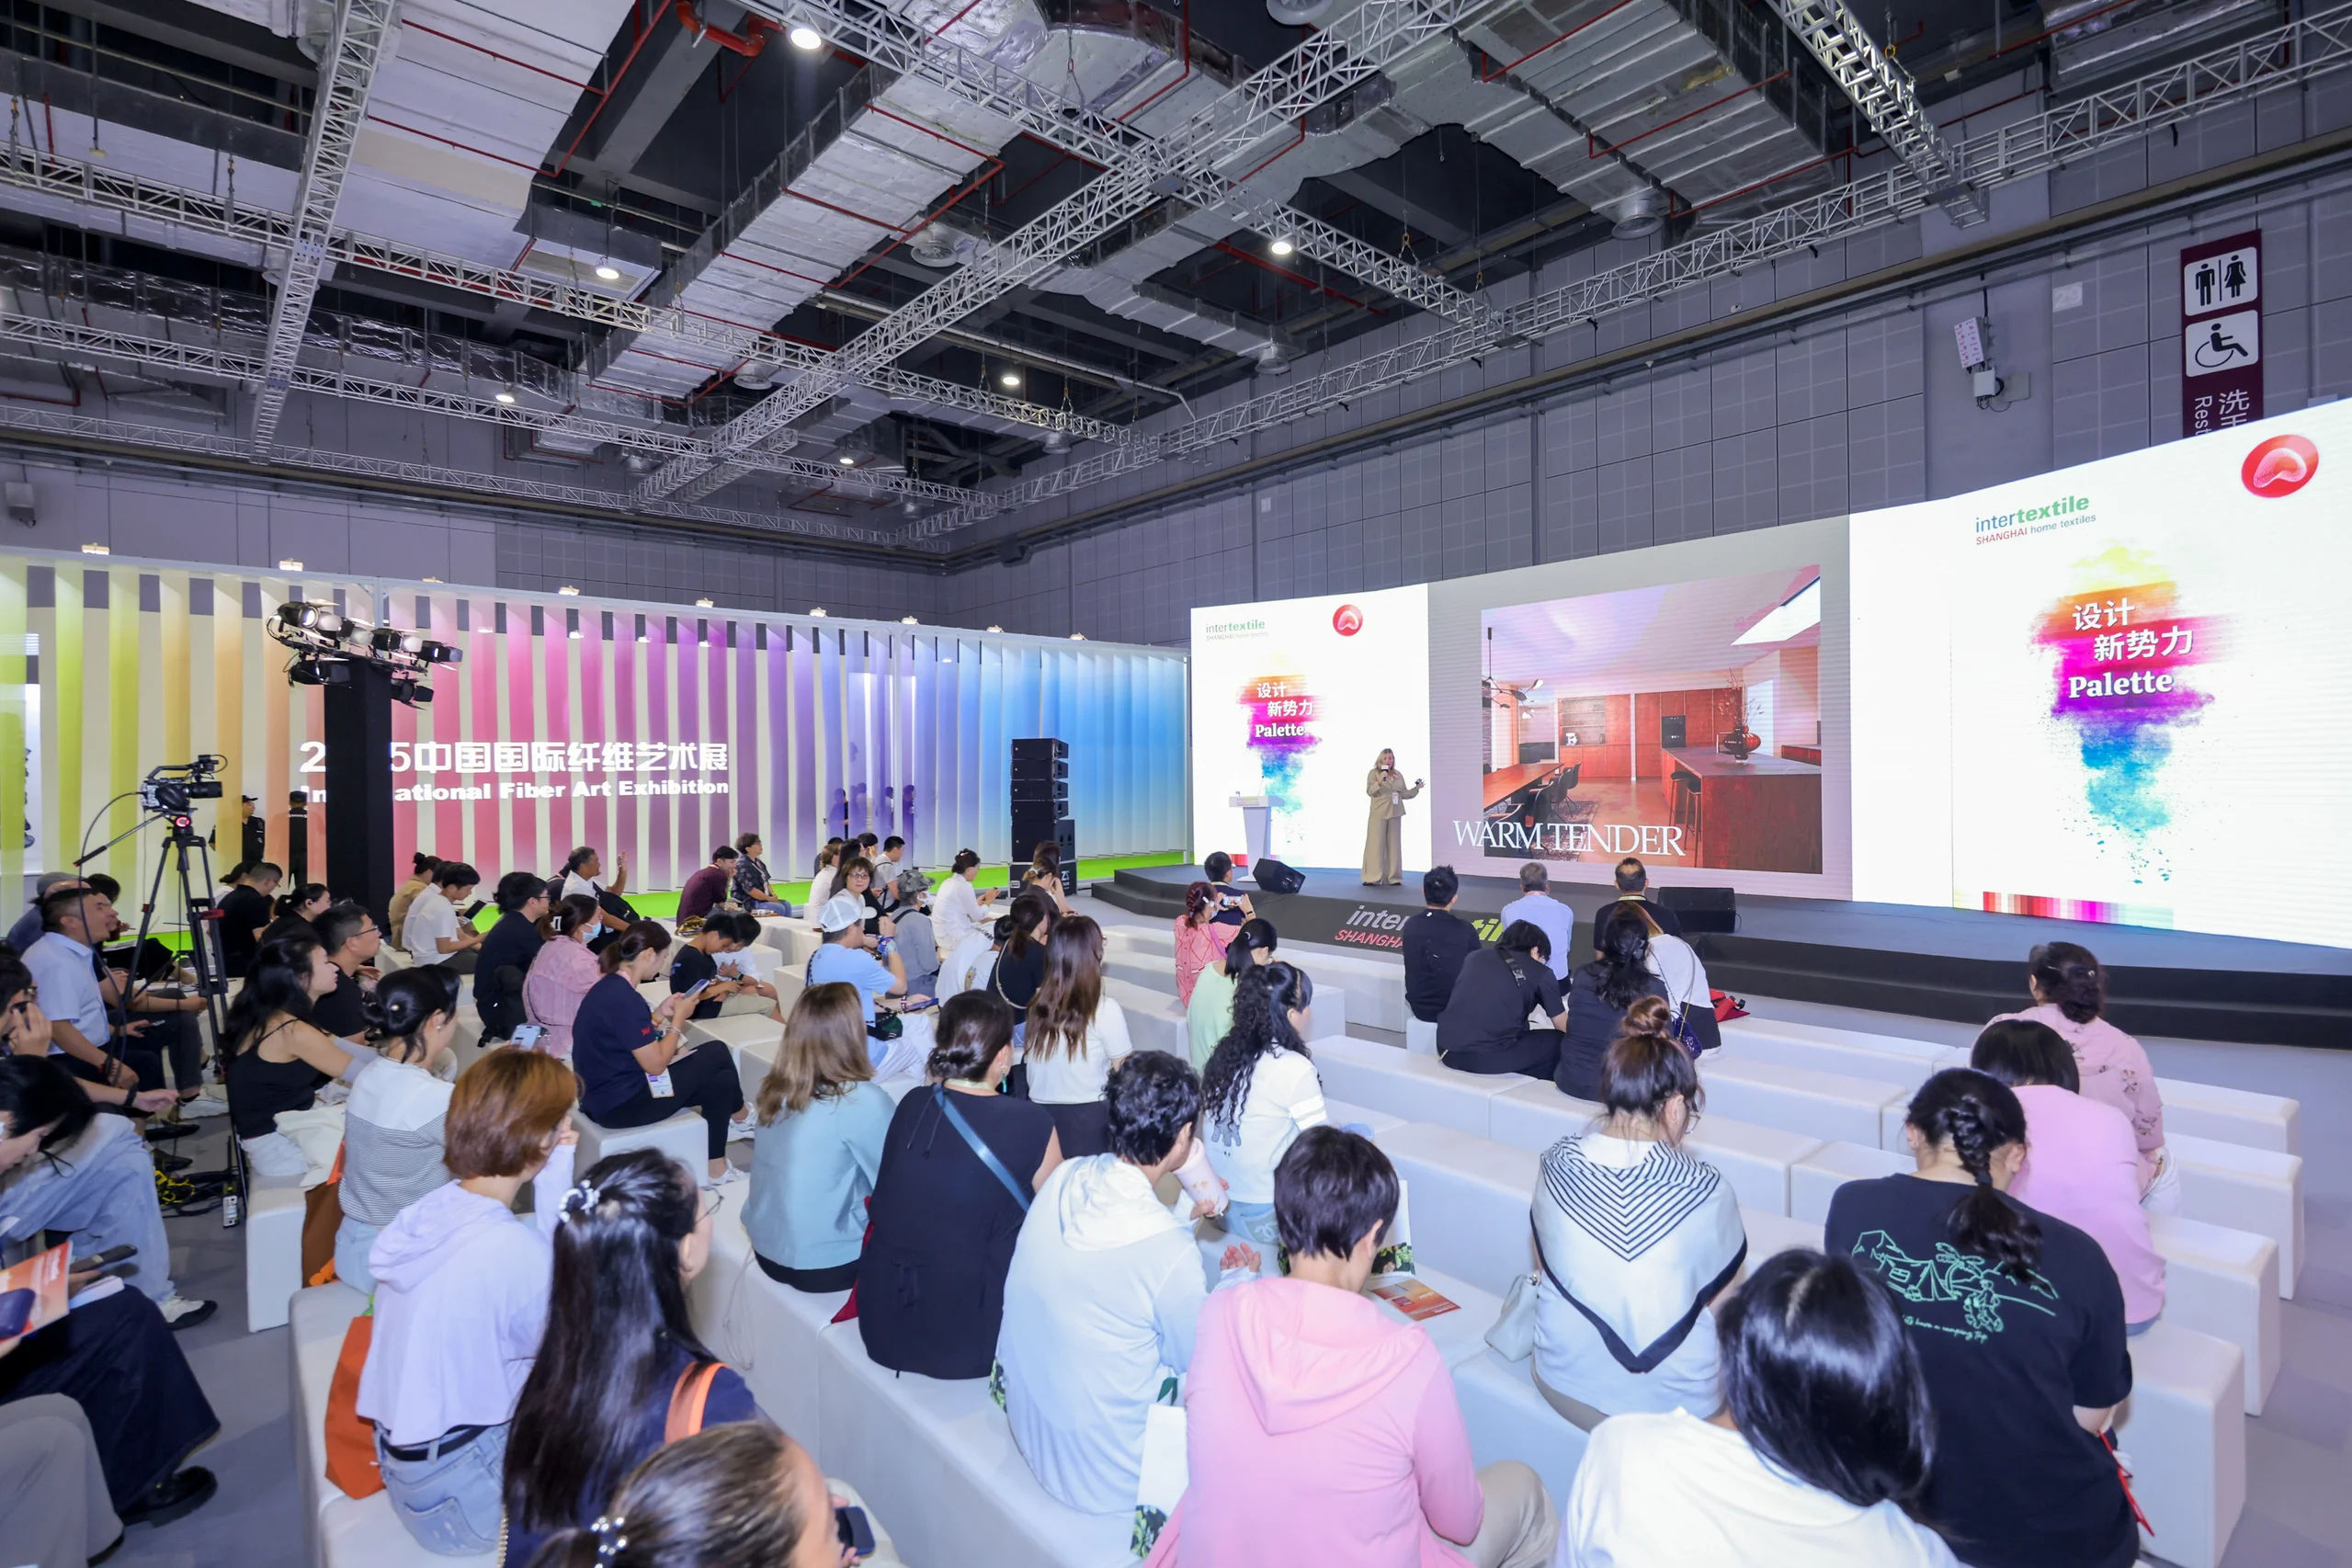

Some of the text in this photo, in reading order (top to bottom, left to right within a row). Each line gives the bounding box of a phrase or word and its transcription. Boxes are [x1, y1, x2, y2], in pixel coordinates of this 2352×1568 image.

[1976, 495, 2089, 533] intertextile
[1976, 515, 2096, 545] SHANGHAI home textiles
[1206, 619, 1266, 633] intertextile
[2072, 597, 2136, 631] 设计
[2094, 625, 2193, 662] 新势力
[1257, 681, 1288, 699] 设计
[2068, 670, 2174, 699] Palette
[1267, 699, 1313, 717] 新势力
[1255, 722, 1304, 738] Palette
[300, 741, 728, 774] 25中国国际纤维艺术展
[499, 782, 566, 800] Fiber
[572, 780, 612, 798] Art
[619, 779, 729, 797] Exhibition
[1453, 820, 1686, 856] WARM TENDER
